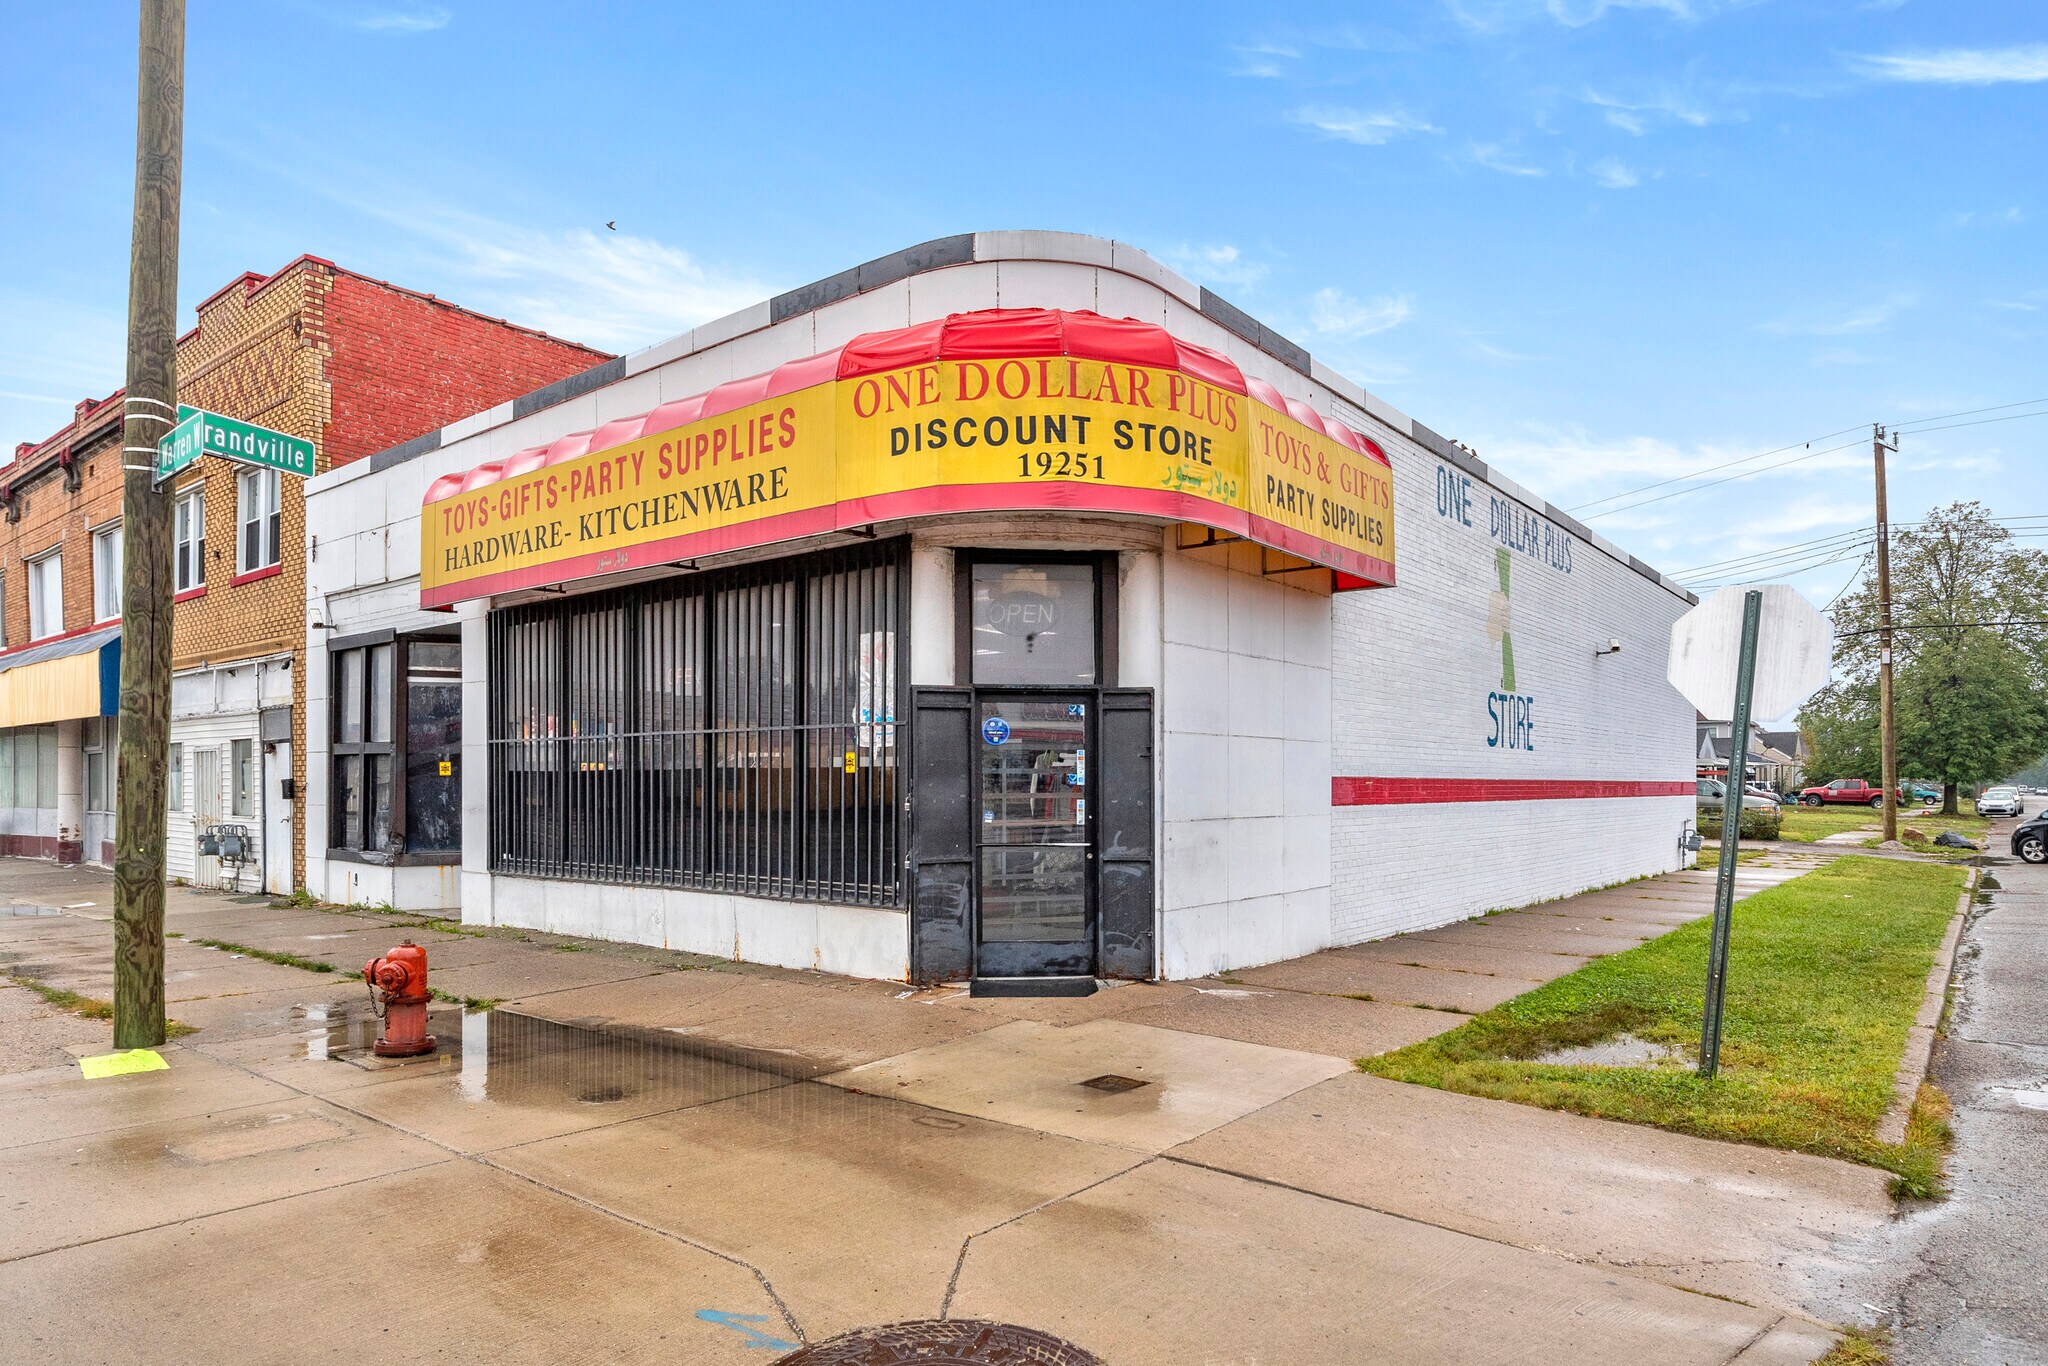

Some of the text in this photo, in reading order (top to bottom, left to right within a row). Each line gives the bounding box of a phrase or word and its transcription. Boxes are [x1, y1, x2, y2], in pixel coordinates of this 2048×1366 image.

[853, 359, 1238, 433] ONE DOLLAR PLUS
[161, 420, 201, 469] Warren W
[204, 424, 305, 469] randville
[658, 407, 796, 480] SUPPLIES
[890, 414, 1213, 466] DISCOUNT STORE
[1018, 450, 1106, 480] 19251
[1259, 420, 1390, 510] TOYS & GIFTS
[444, 466, 789, 573] HARDWARE- KITCHENWARE
[1266, 474, 1383, 547] PARTY SUPPLIES
[1436, 464, 1573, 574] ONE DOLLAR PLUS
[989, 604, 1054, 624] OPEN
[1486, 691, 1534, 752] STORE
